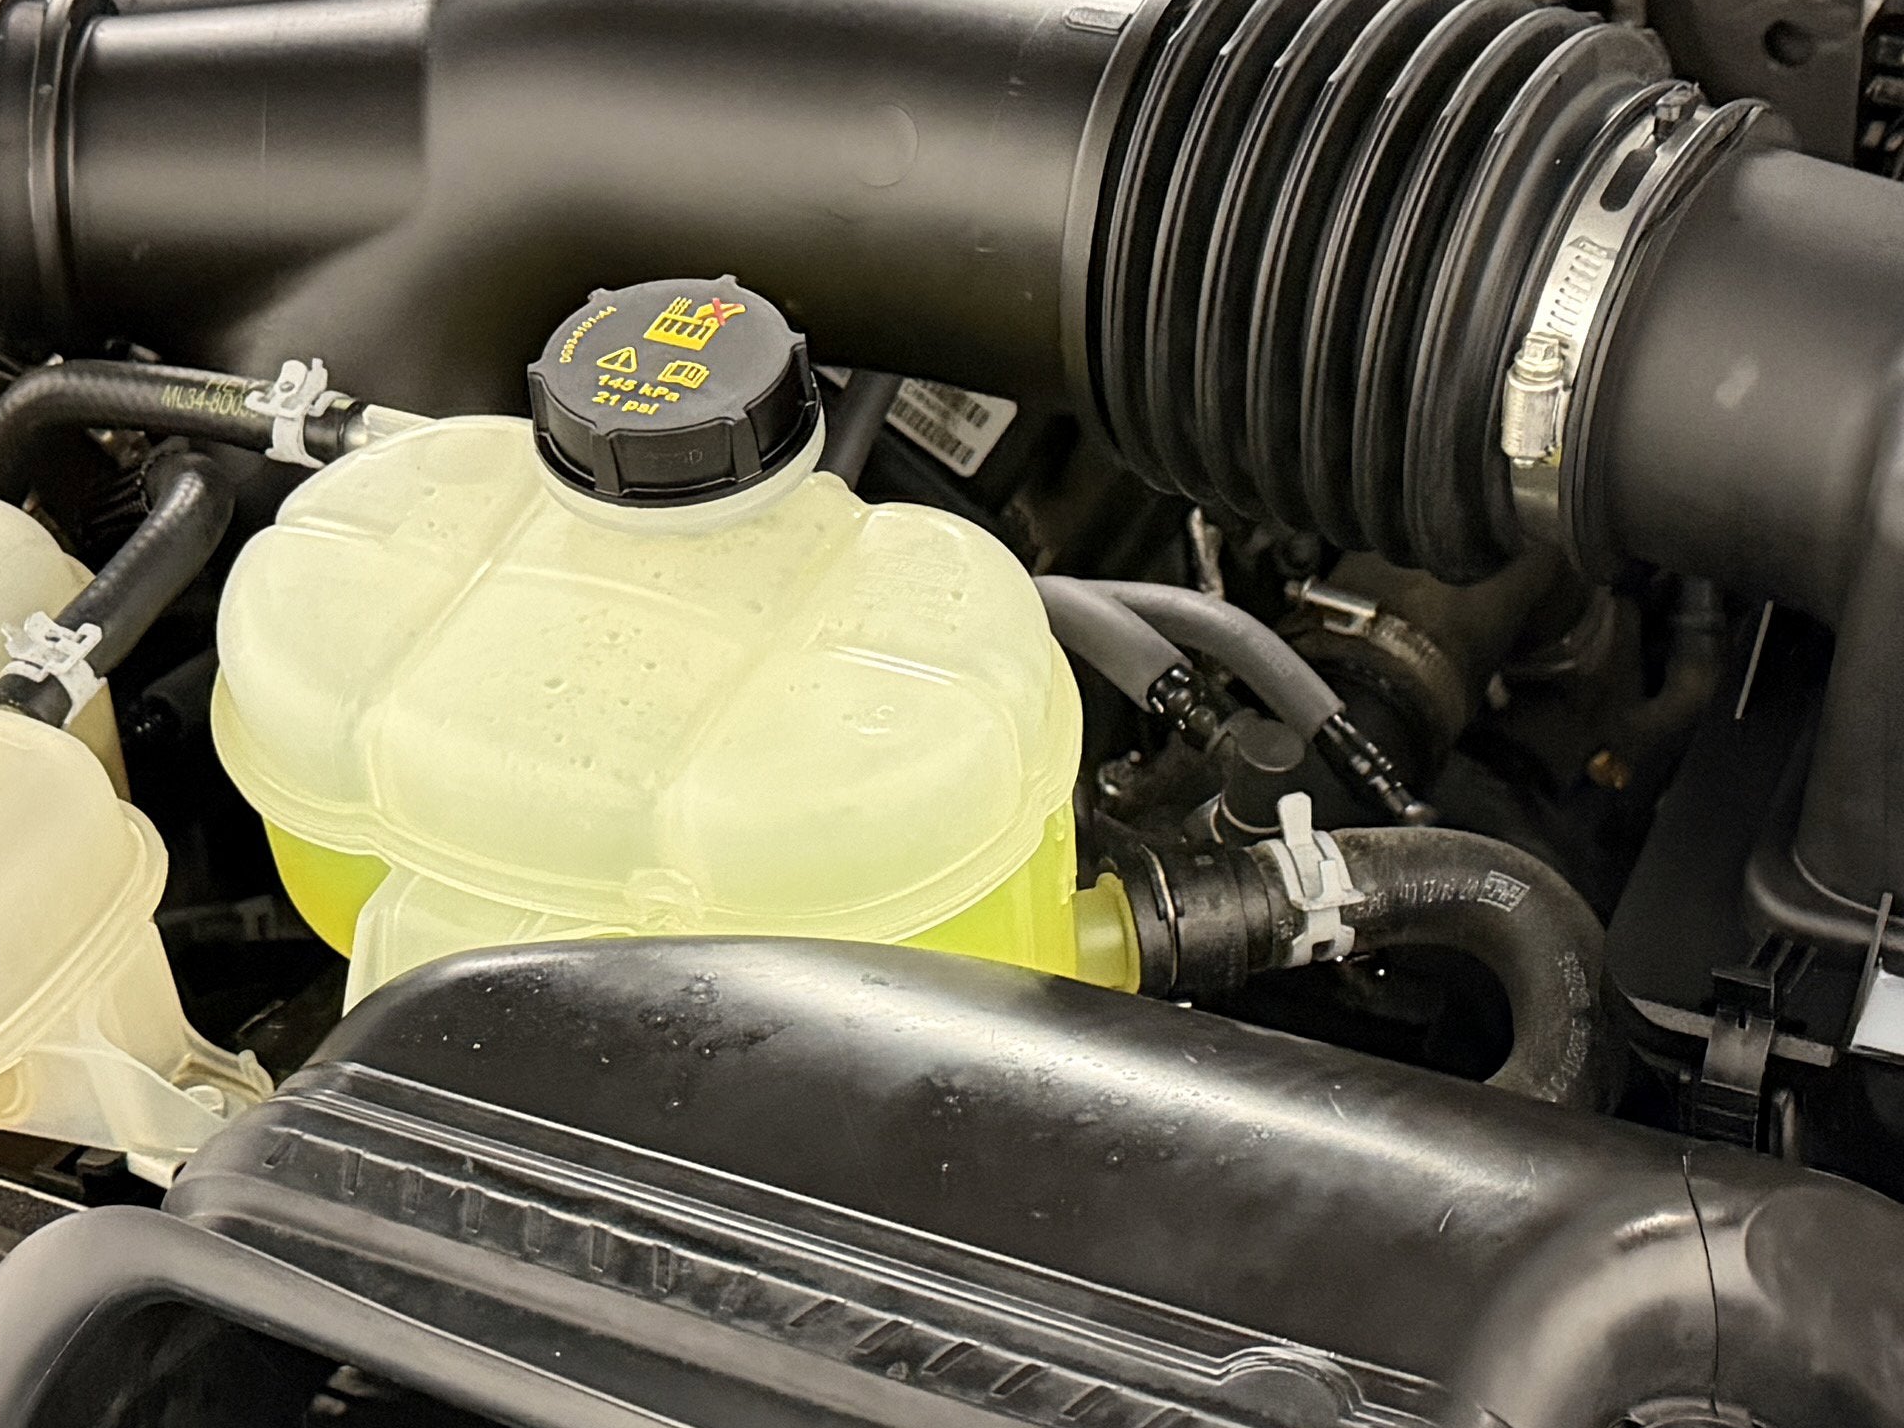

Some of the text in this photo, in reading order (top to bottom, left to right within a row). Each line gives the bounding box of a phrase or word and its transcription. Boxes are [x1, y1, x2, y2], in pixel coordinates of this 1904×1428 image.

[597, 374, 681, 403] 145 kPa
[591, 390, 660, 416] 21 psi
